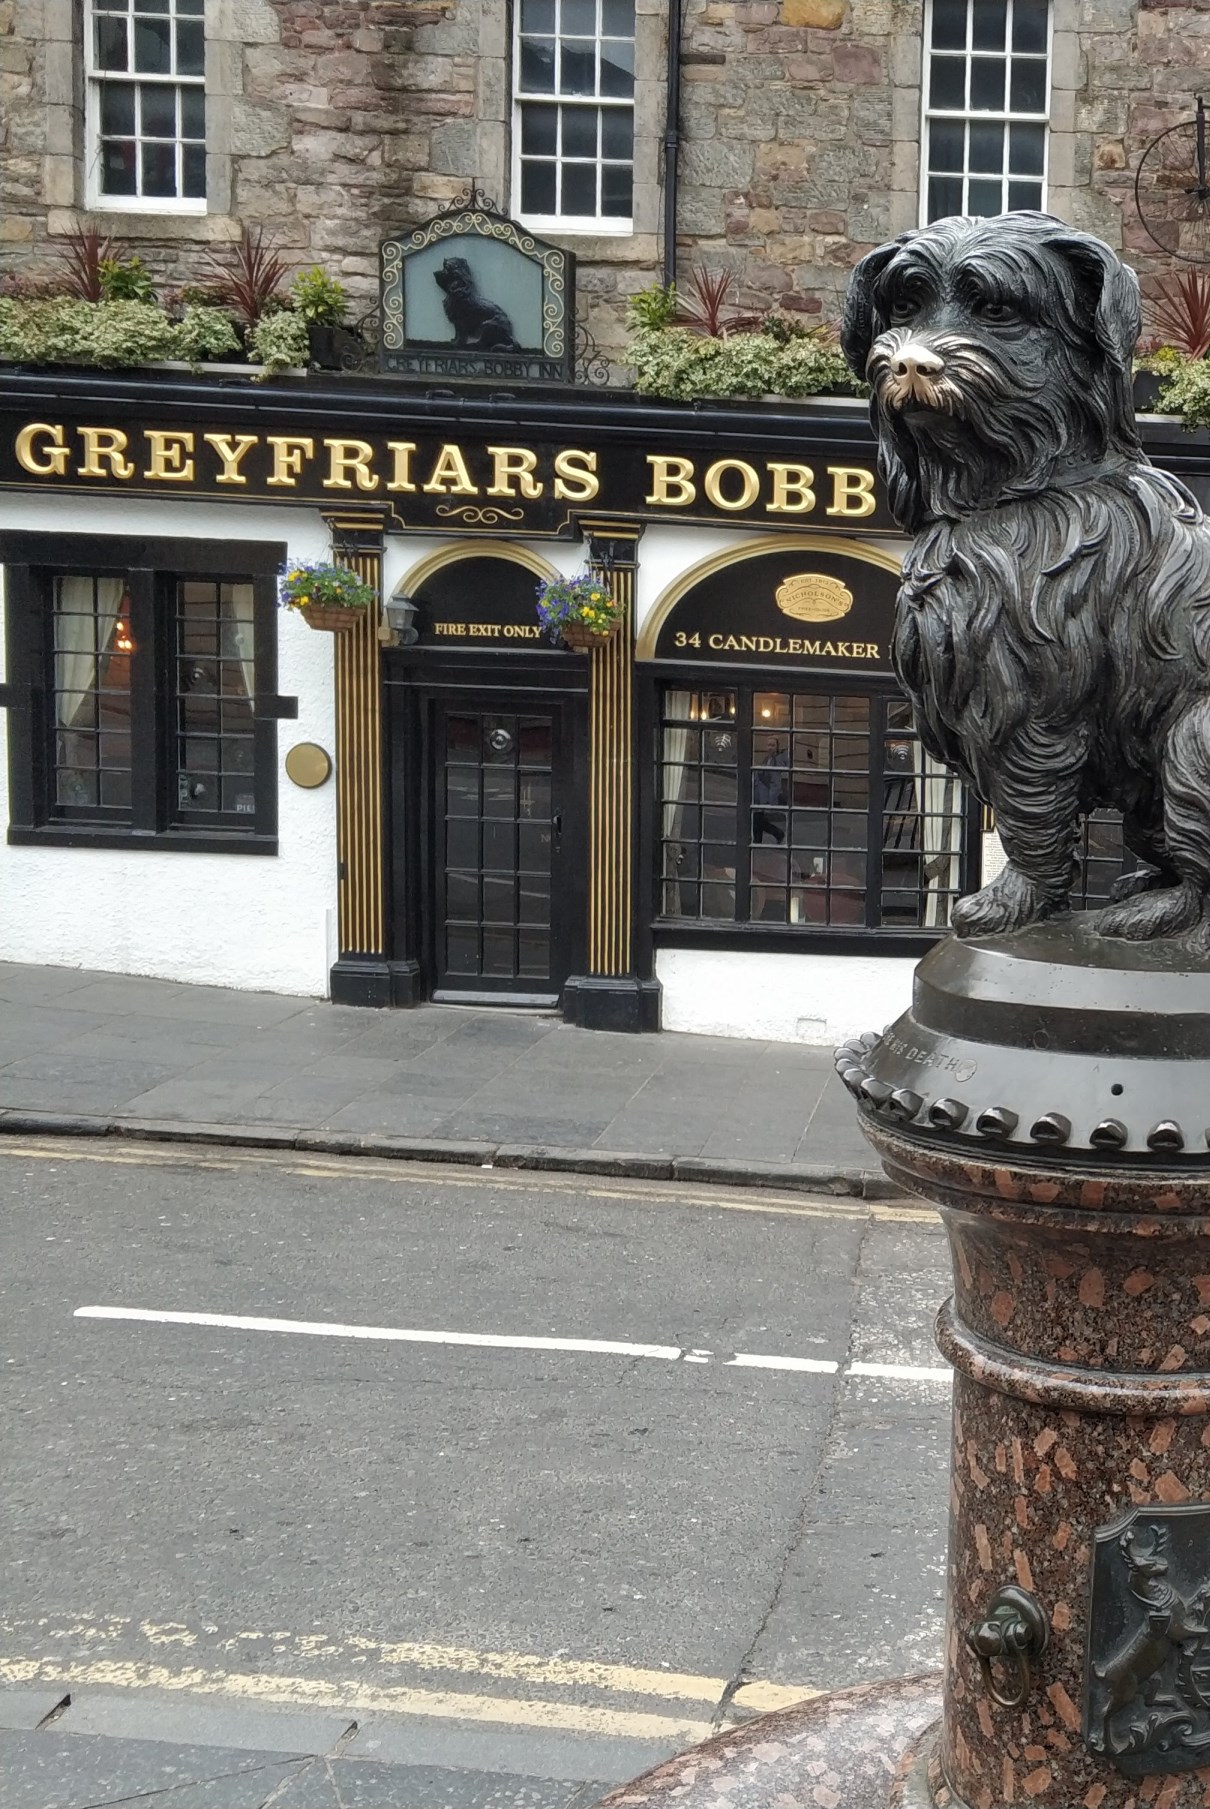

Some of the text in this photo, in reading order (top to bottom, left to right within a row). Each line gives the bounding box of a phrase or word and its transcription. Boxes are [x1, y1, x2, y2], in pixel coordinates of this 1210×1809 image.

[483, 360, 531, 377] BOBBY
[538, 362, 563, 379] INN
[15, 423, 877, 518] GREYFRIARS BOBB
[435, 622, 542, 639] FIRE EXIT ONLY
[674, 632, 702, 648] 34
[709, 634, 881, 659] CANDLEMAKER
[904, 1046, 960, 1072] DEATH
